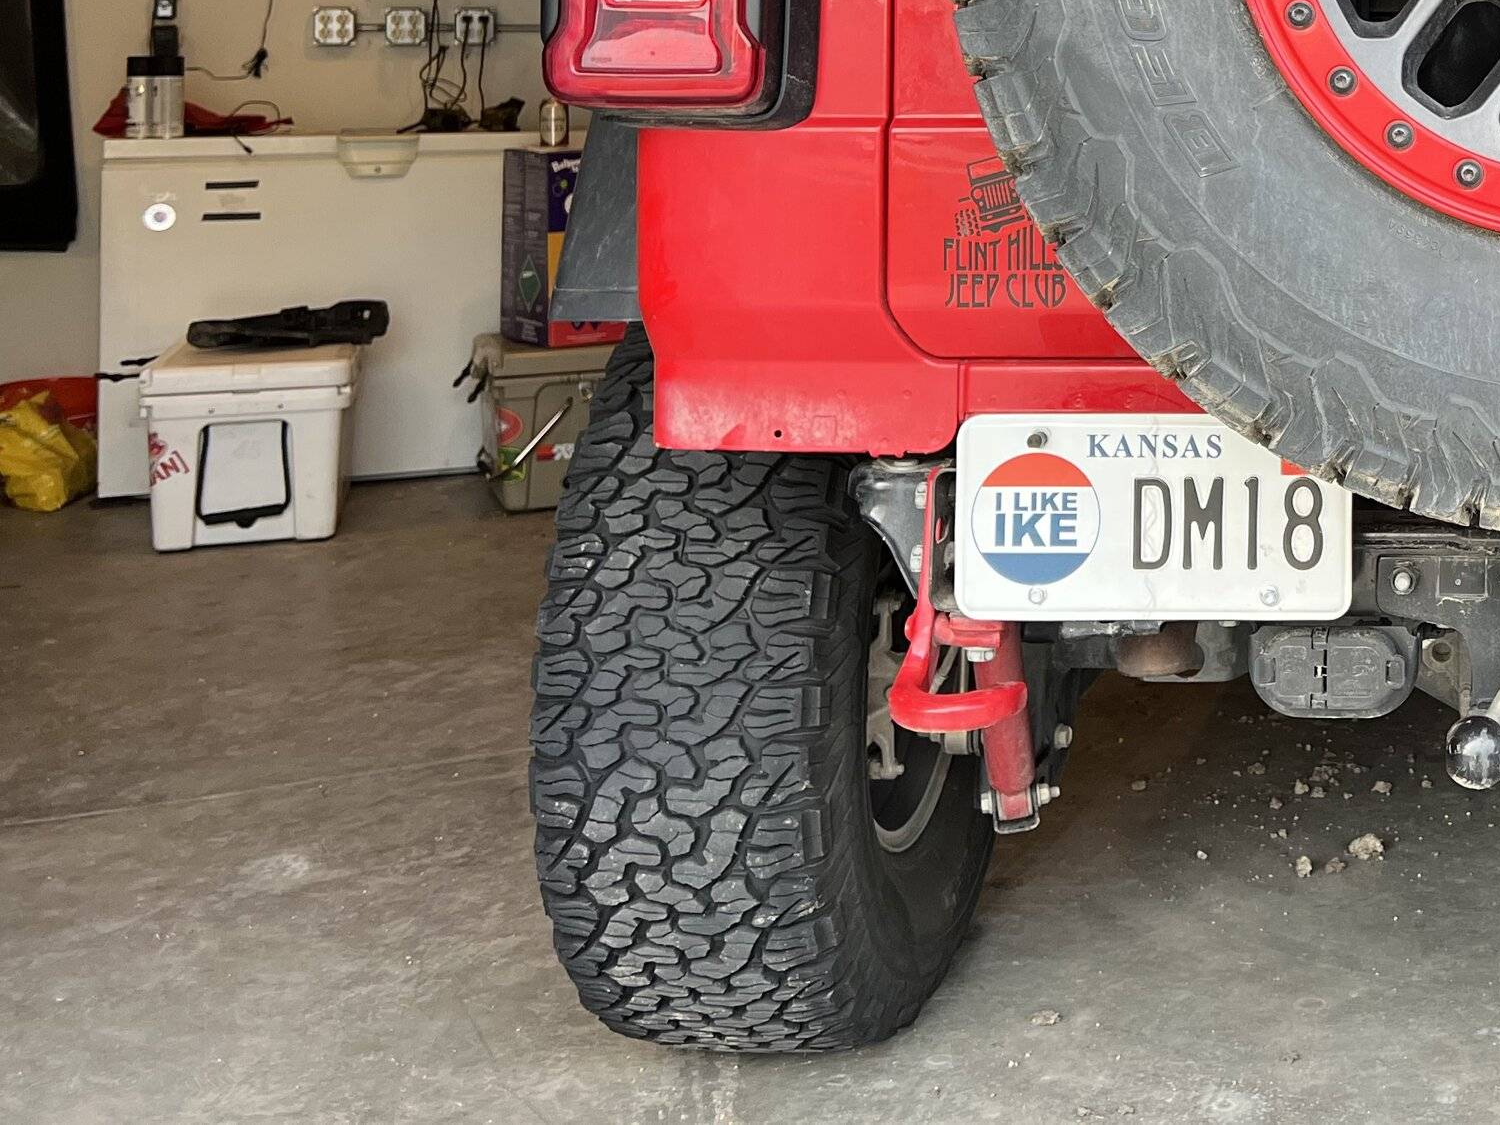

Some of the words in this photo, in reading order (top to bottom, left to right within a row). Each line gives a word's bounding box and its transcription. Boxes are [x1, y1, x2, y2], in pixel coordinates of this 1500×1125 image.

[943, 238, 1002, 271] FLINT
[945, 273, 1000, 308] JEEP
[1006, 273, 1067, 308] CLUB
[1086, 433, 1222, 459] KANSAS
[995, 492, 1002, 512] I
[1014, 492, 1078, 512] LIKE
[994, 513, 1078, 547] IKE
[1132, 476, 1324, 571] DM18
